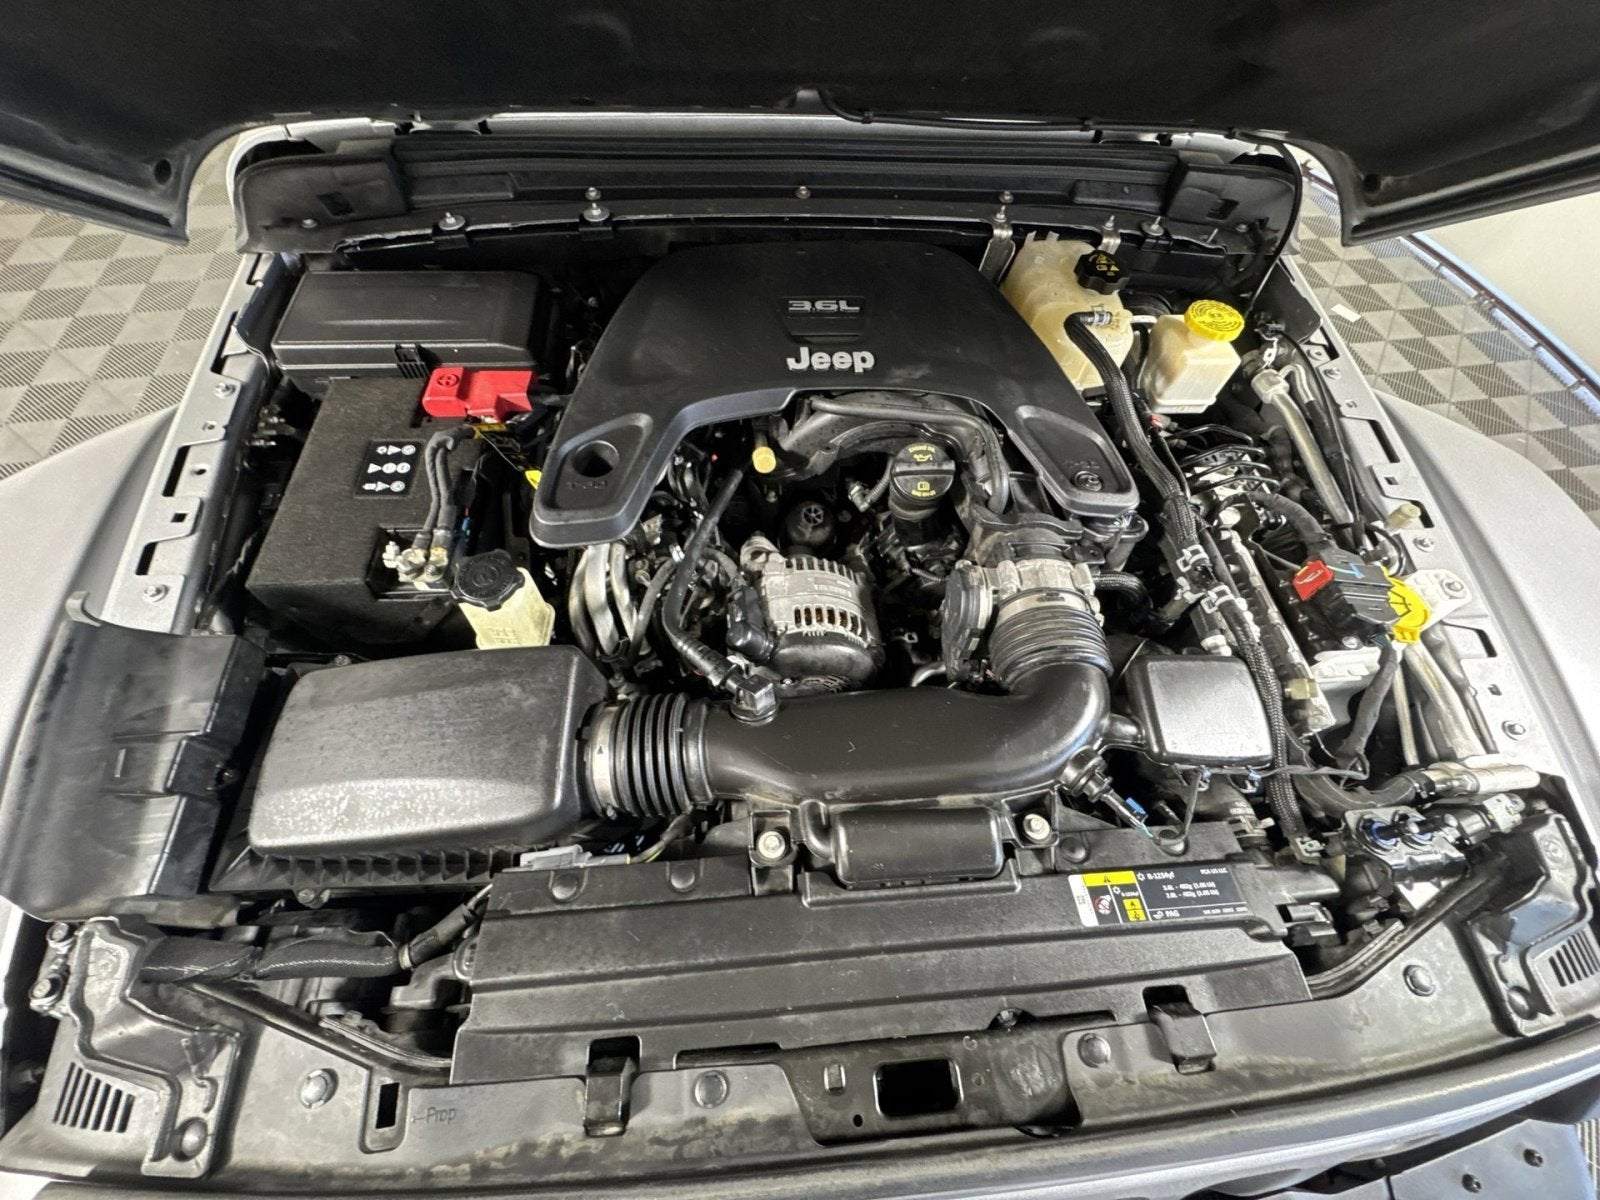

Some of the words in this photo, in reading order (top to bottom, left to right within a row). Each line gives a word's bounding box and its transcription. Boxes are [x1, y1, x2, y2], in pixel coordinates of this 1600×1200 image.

[788, 300, 860, 312] 3.6L
[786, 346, 875, 374] Jeep
[1165, 910, 1180, 918] PAG
[427, 1106, 456, 1125] Prop
